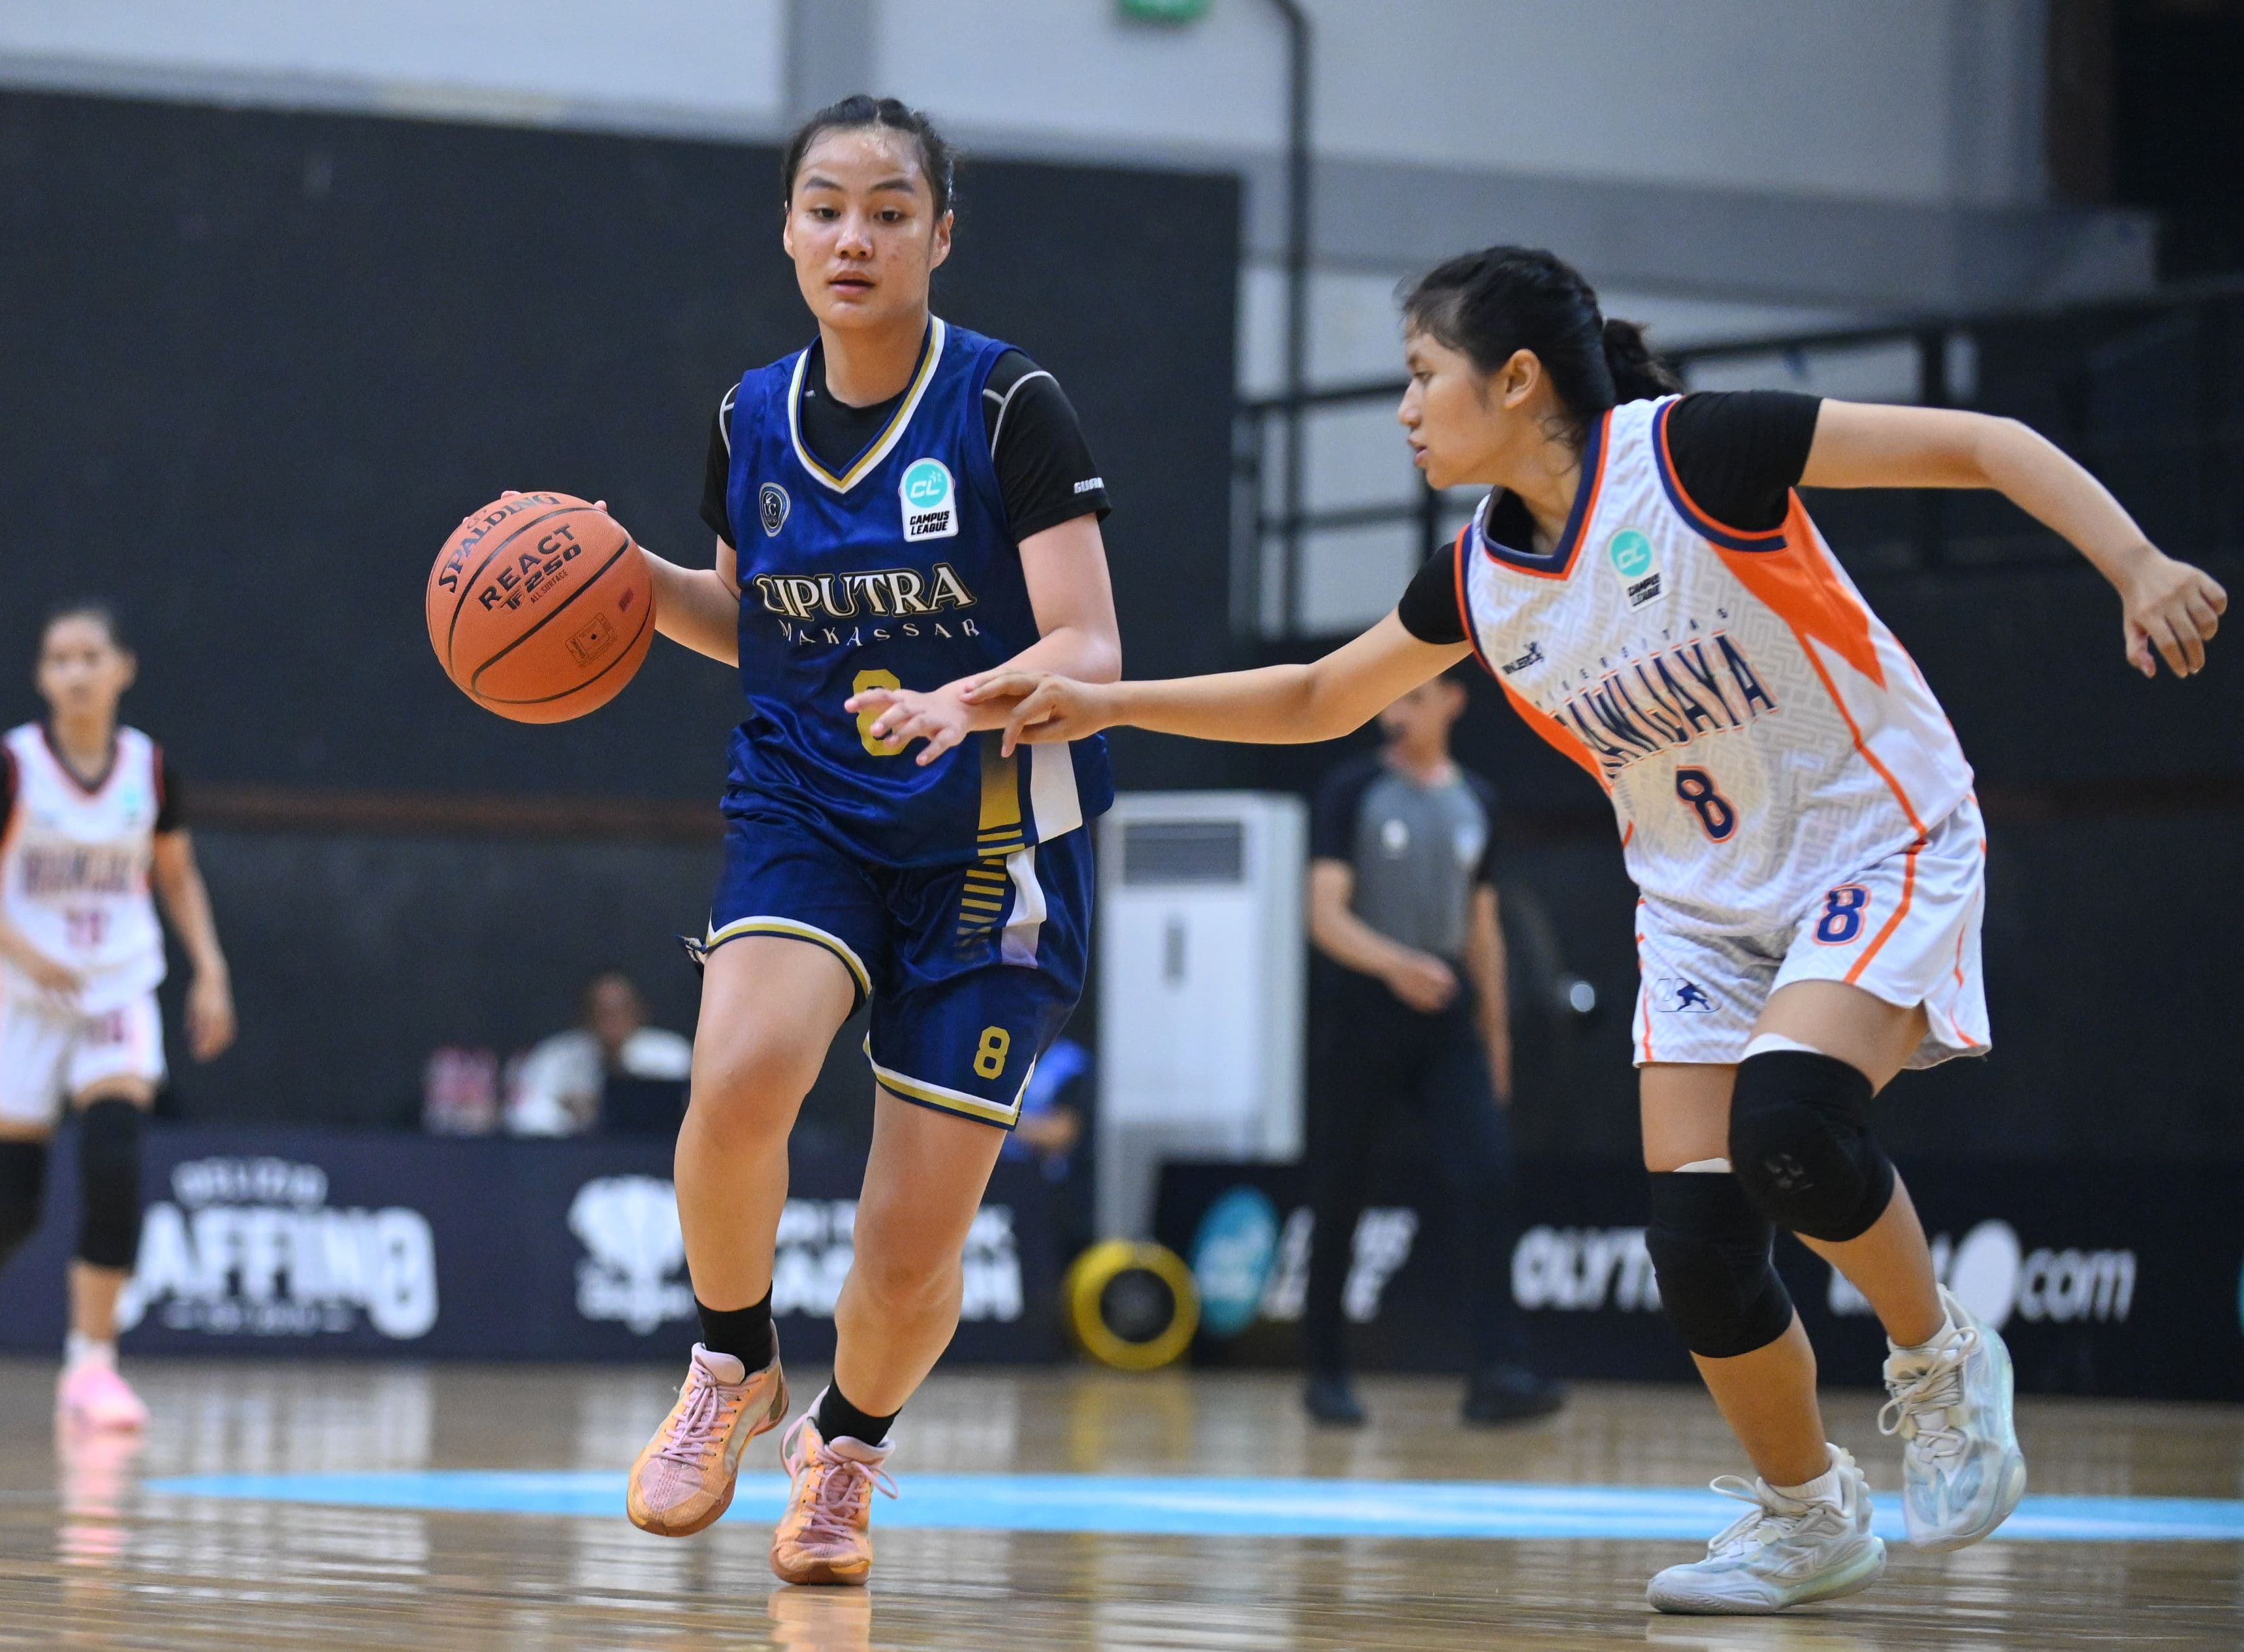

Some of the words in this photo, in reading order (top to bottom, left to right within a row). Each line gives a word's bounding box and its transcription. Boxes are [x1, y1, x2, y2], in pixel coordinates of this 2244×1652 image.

[910, 480, 940, 498] CL
[763, 503, 777, 516] UC
[910, 510, 950, 526] CAMPUS
[438, 494, 561, 594] SPALDING
[910, 521, 949, 535] LEAGUE
[478, 522, 575, 611] REACT
[530, 589, 543, 604] ALL
[542, 569, 569, 594] SURFACE
[778, 618, 980, 646] MAKASSAR
[1675, 765, 1739, 843] 8
[1812, 883, 1873, 946] 8
[973, 1026, 1010, 1080] 8
